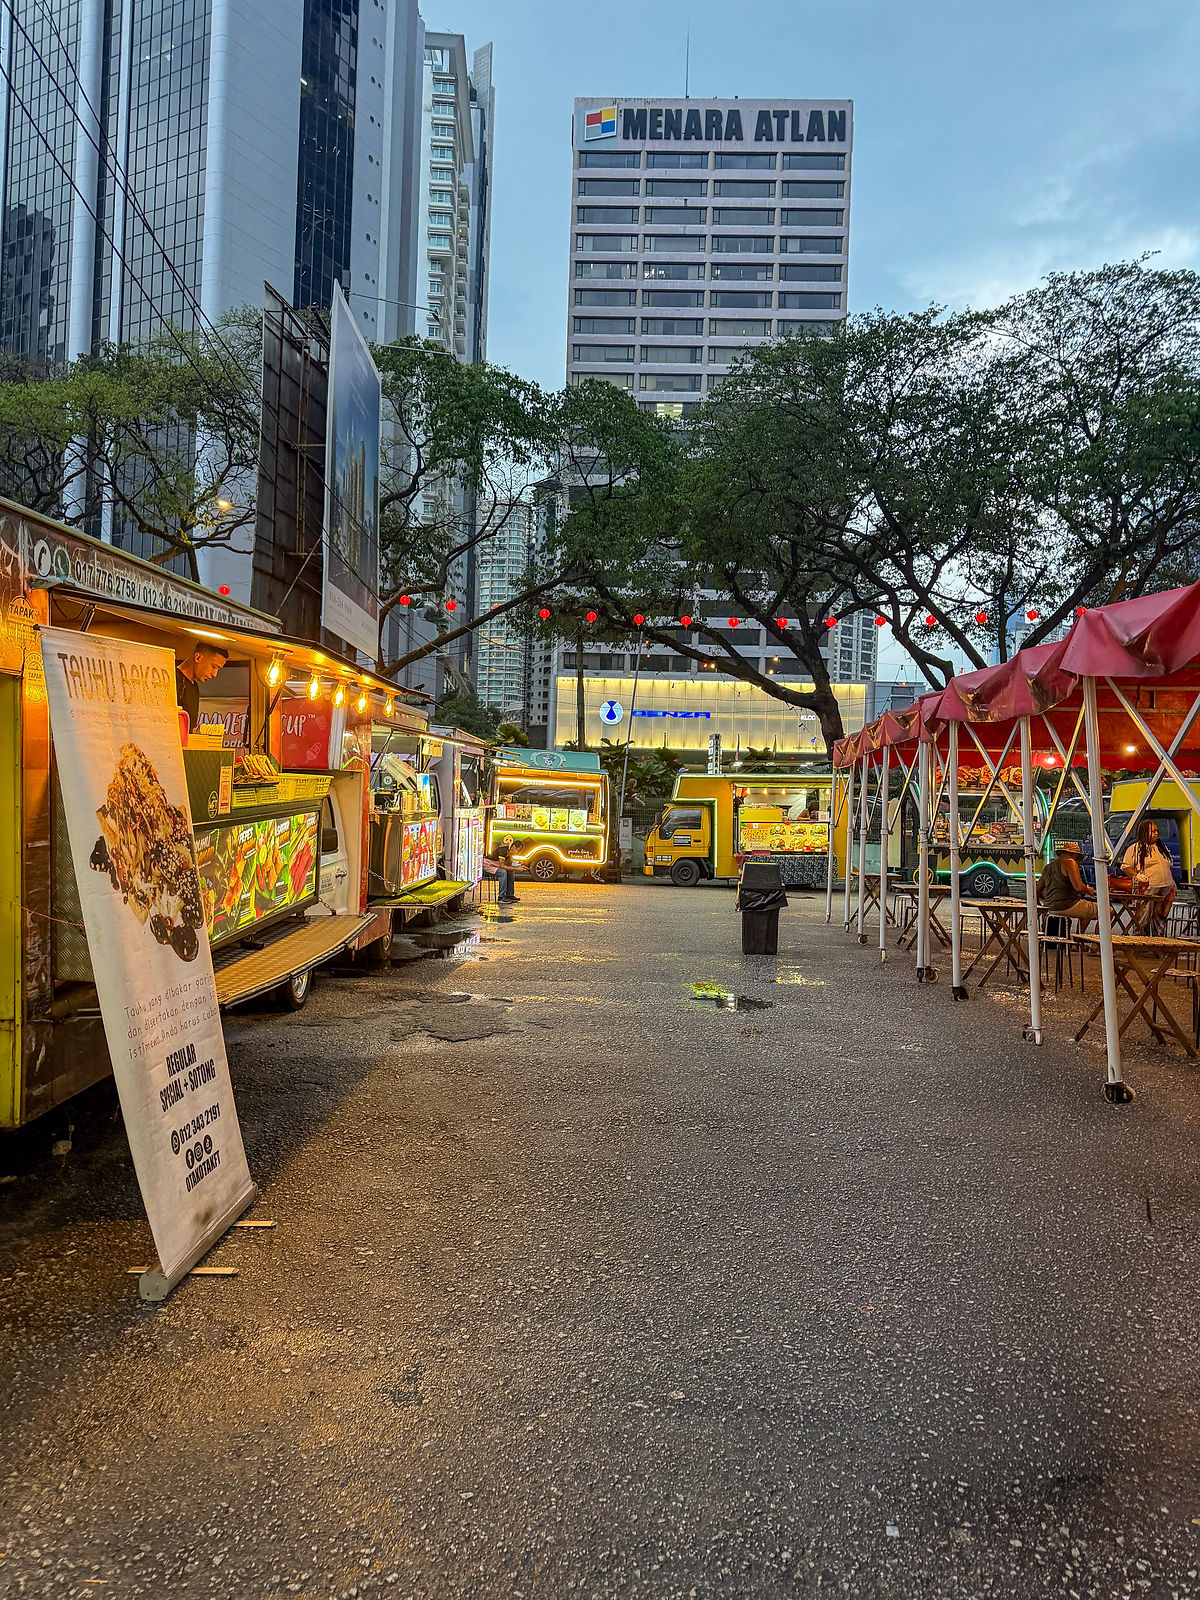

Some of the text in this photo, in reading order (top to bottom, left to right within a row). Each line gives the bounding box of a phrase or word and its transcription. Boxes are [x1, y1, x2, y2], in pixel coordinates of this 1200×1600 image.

[622, 108, 846, 142] MENARA ATLAN
[76, 560, 94, 585] 017
[116, 575, 136, 599] 2758
[143, 586, 157, 607] 012
[9, 603, 35, 620] TAPAK
[57, 652, 116, 703] TAUHU
[164, 983, 192, 1001] dibakar
[127, 1026, 143, 1039] dan
[144, 1007, 179, 1032] disertakan
[181, 995, 207, 1012] dengan
[180, 1014, 201, 1032] harus
[165, 1043, 197, 1078] REGULAR
[159, 1077, 185, 1113] SPECIAL
[188, 1058, 217, 1092] SOTONG
[180, 1102, 221, 1145] 012 343 2191
[185, 1150, 221, 1193] OTAKOTAKFT
